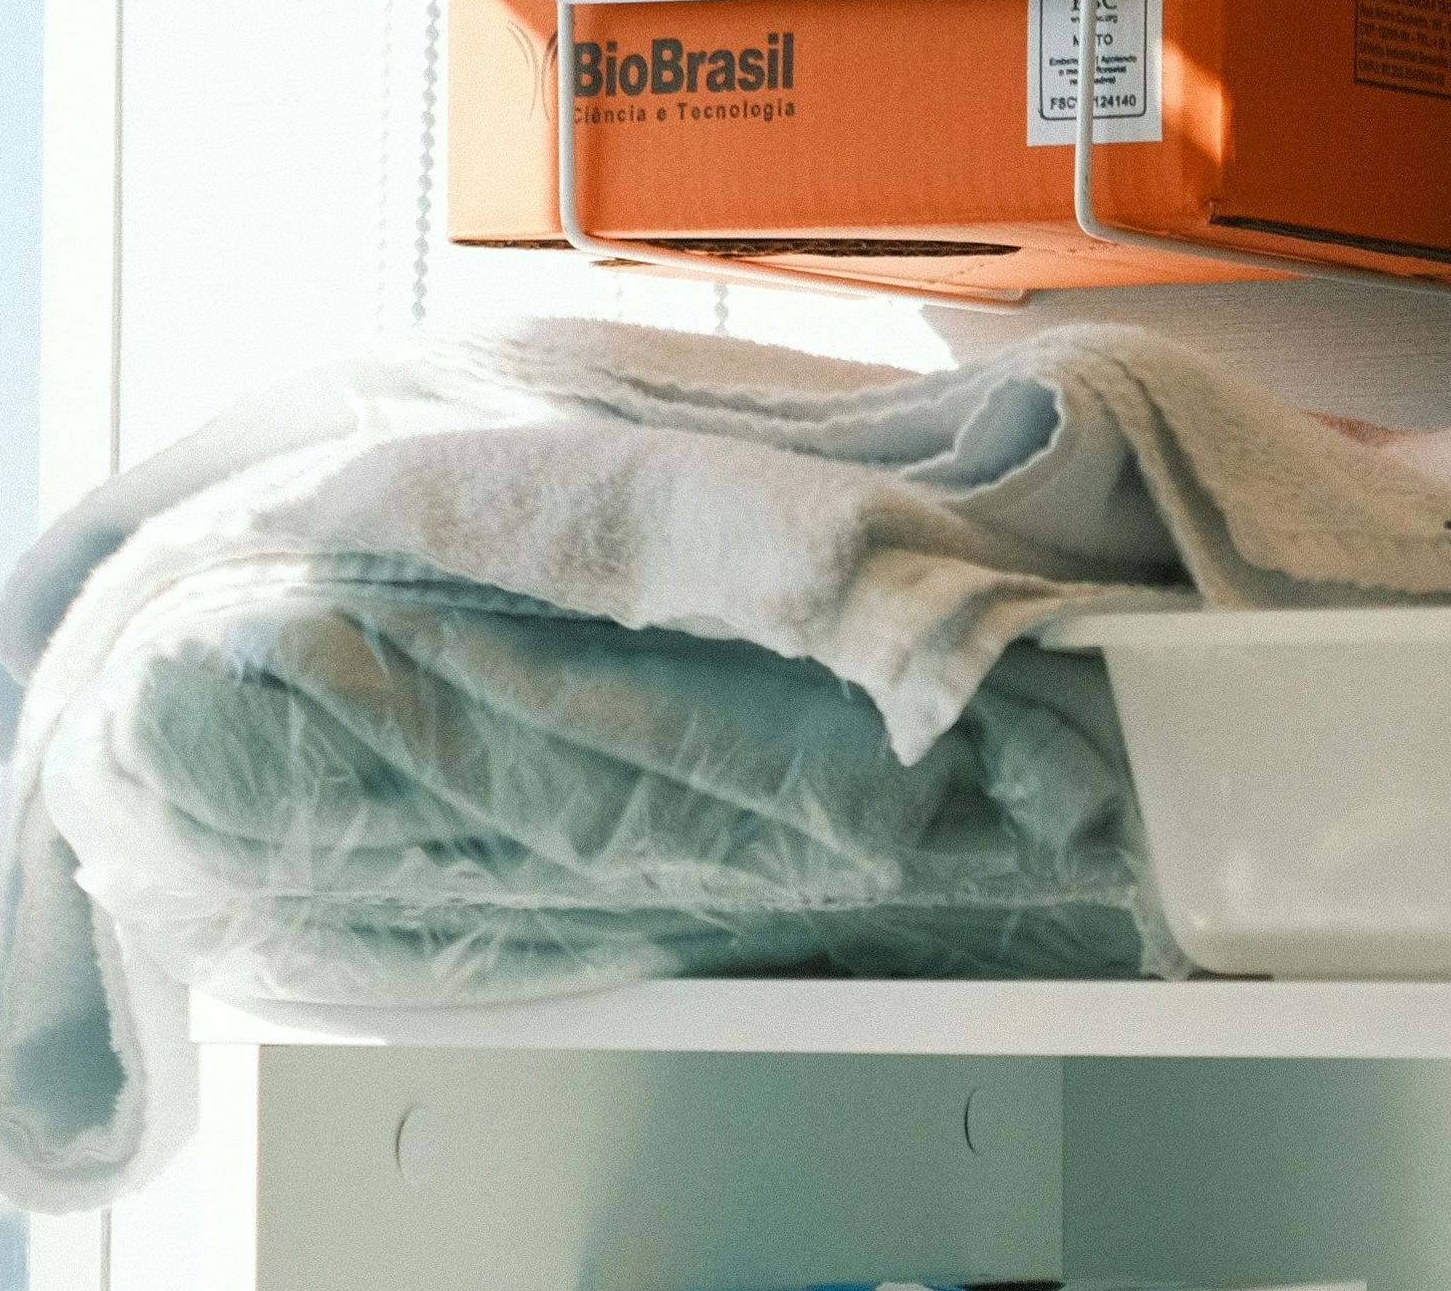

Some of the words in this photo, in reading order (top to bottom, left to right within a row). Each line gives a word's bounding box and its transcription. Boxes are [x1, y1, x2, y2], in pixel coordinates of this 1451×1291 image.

[573, 32, 795, 98] BioBrasil
[656, 108, 666, 122] e
[677, 100, 796, 123] Tecnologia
